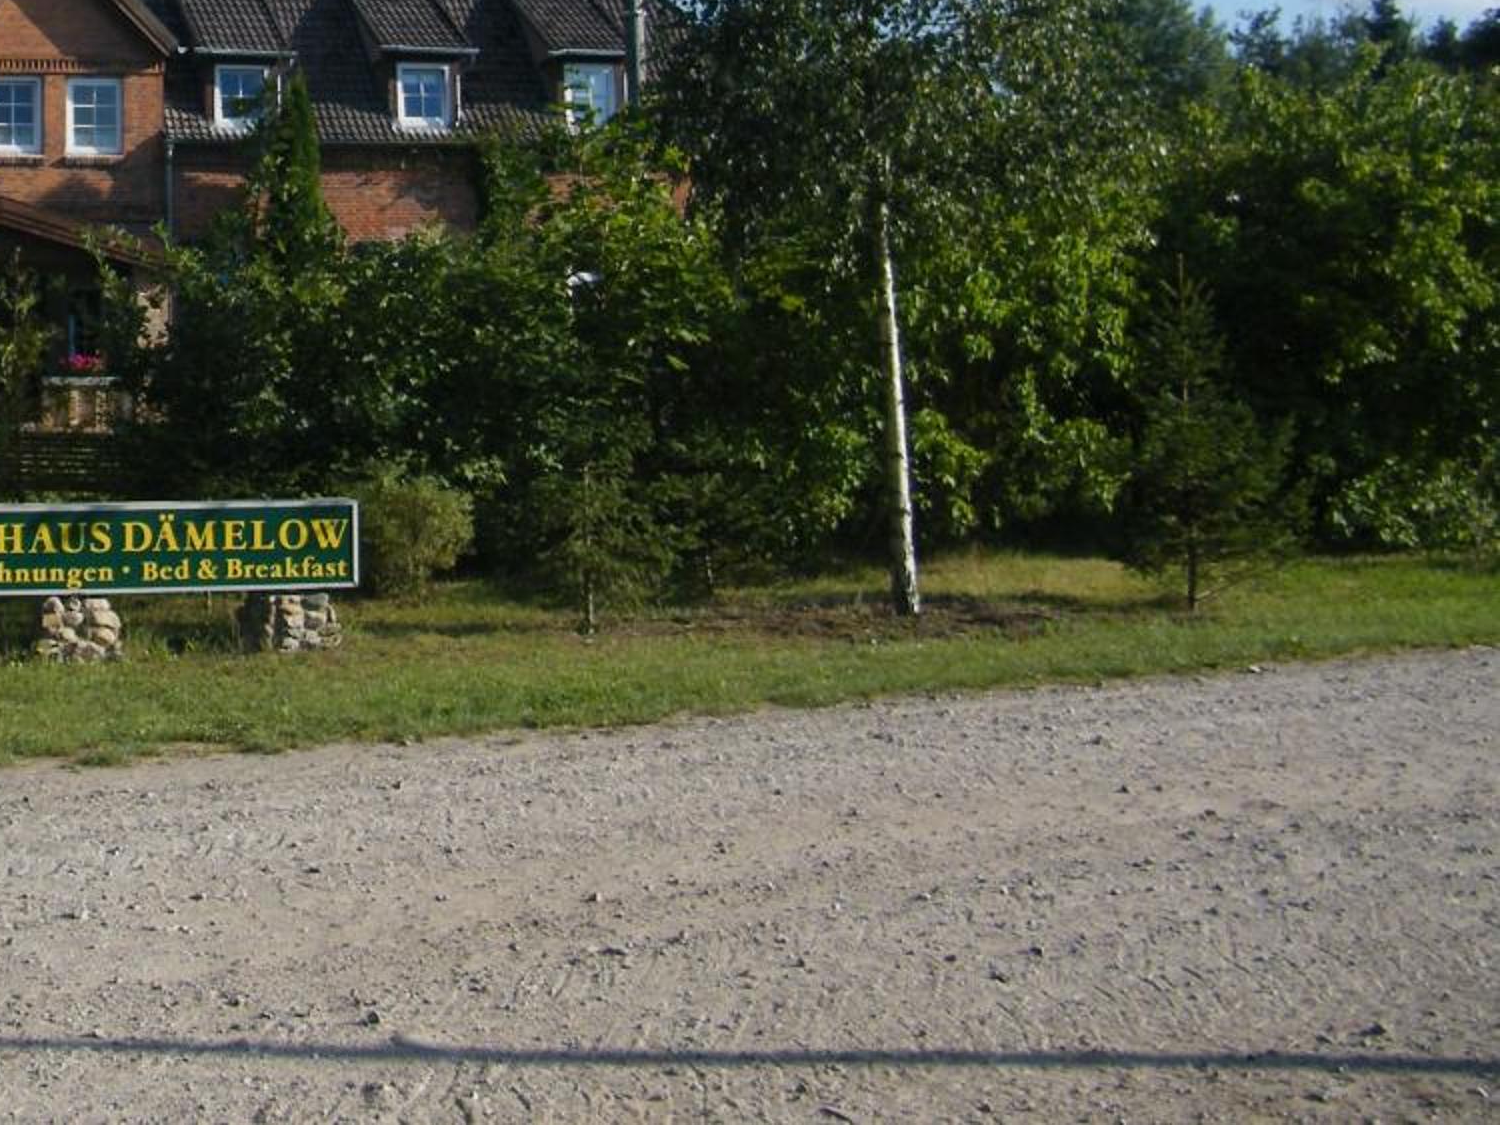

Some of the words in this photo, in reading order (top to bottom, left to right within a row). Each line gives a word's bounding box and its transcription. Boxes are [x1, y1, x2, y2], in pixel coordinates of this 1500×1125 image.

[120, 513, 348, 552] DÄMELOW
[142, 559, 190, 581] Bed
[196, 557, 218, 580] &
[225, 555, 348, 579] Breakfast
